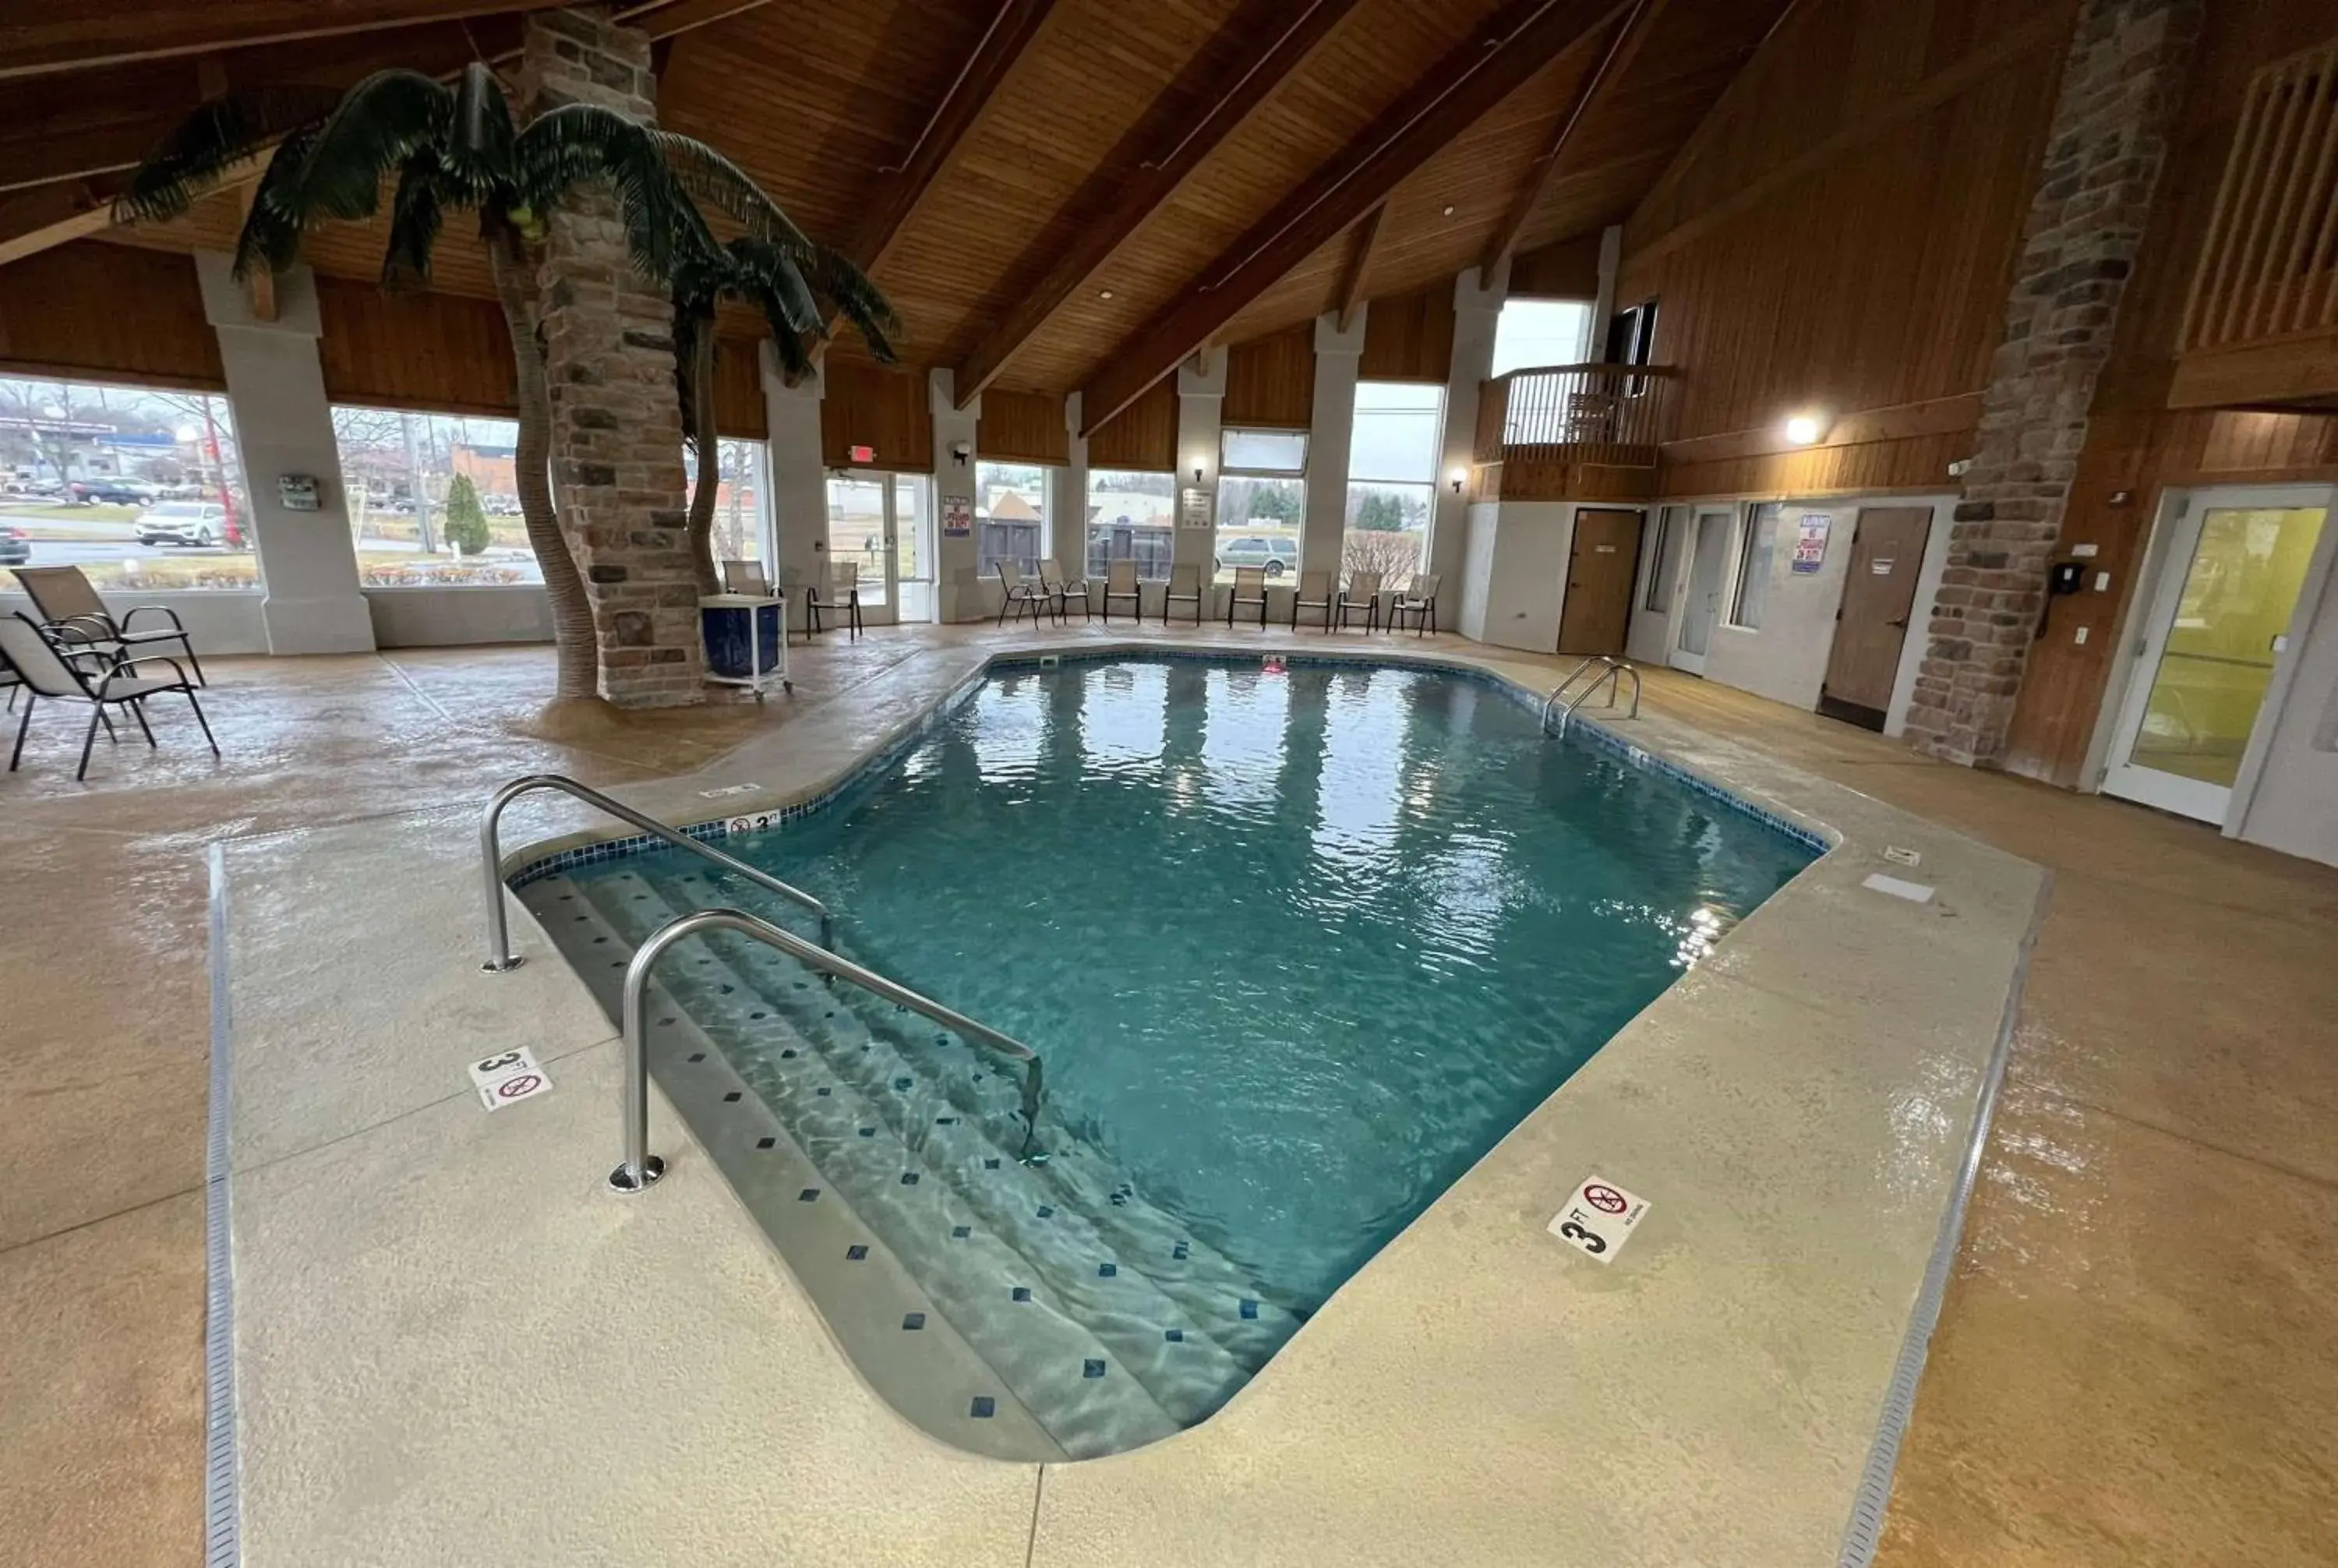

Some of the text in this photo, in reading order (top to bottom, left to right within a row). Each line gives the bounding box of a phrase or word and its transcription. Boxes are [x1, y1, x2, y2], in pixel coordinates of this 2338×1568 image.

[479, 1052, 521, 1072] 3
[1561, 1208, 1607, 1254] 3 FT
